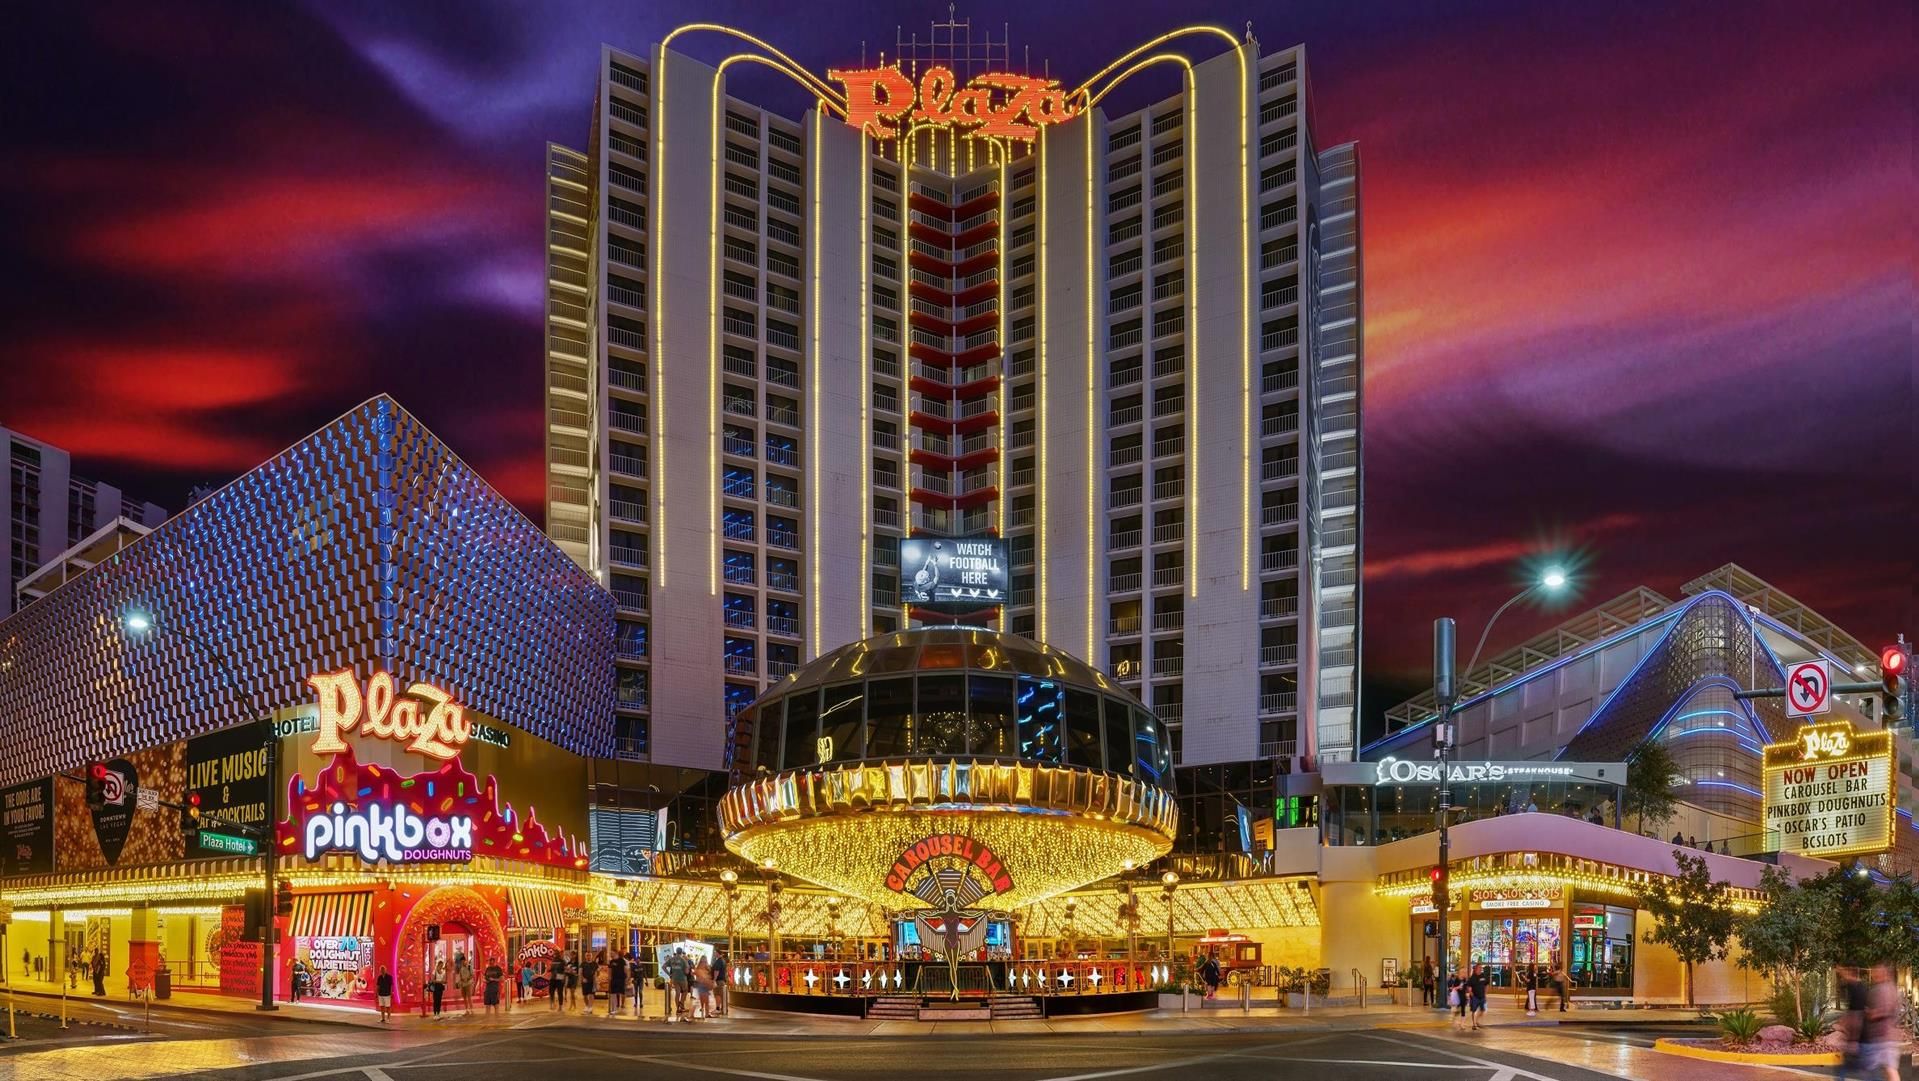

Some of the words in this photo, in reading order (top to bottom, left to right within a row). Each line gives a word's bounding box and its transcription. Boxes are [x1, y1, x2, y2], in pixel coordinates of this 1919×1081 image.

[828, 66, 1084, 142] Plaza
[956, 544, 992, 556] WATCH
[949, 557, 1000, 571] FOOTBALL
[961, 572, 988, 585] HERE
[307, 670, 471, 759] Plaza
[272, 716, 320, 737] HOTEL
[1803, 730, 1850, 760] Plaza
[190, 759, 219, 789] LIVE
[222, 748, 268, 784] MUSIC
[1783, 767, 1816, 786] NOW
[1828, 761, 1868, 780] OPEN
[222, 786, 229, 803] &
[1784, 782, 1837, 800] CAROUSEL
[1846, 778, 1868, 793] BAR
[217, 802, 265, 824] COCKTAILS
[1767, 802, 1811, 819] PINKBOX
[1818, 793, 1886, 813] DOUGHNUTS
[306, 802, 472, 860] pinkbox
[1784, 817, 1827, 834] OSCAR'S
[1835, 812, 1866, 829] PATIO
[203, 834, 223, 849] Plaza
[225, 838, 246, 852] Hotel
[1802, 833, 1847, 849] BCSLOTS
[404, 850, 472, 860] DOUGHNUTS
[887, 835, 973, 892] CAROUSEL
[976, 847, 1011, 892] BAR
[1472, 889, 1497, 902] SLOTS
[1502, 888, 1526, 900] SLOTS
[1531, 887, 1560, 899] SLOTS
[313, 939, 338, 950] OVER
[339, 936, 358, 952] 70
[309, 950, 360, 961] DOUGHNUT
[312, 960, 358, 971] VARIETIES
